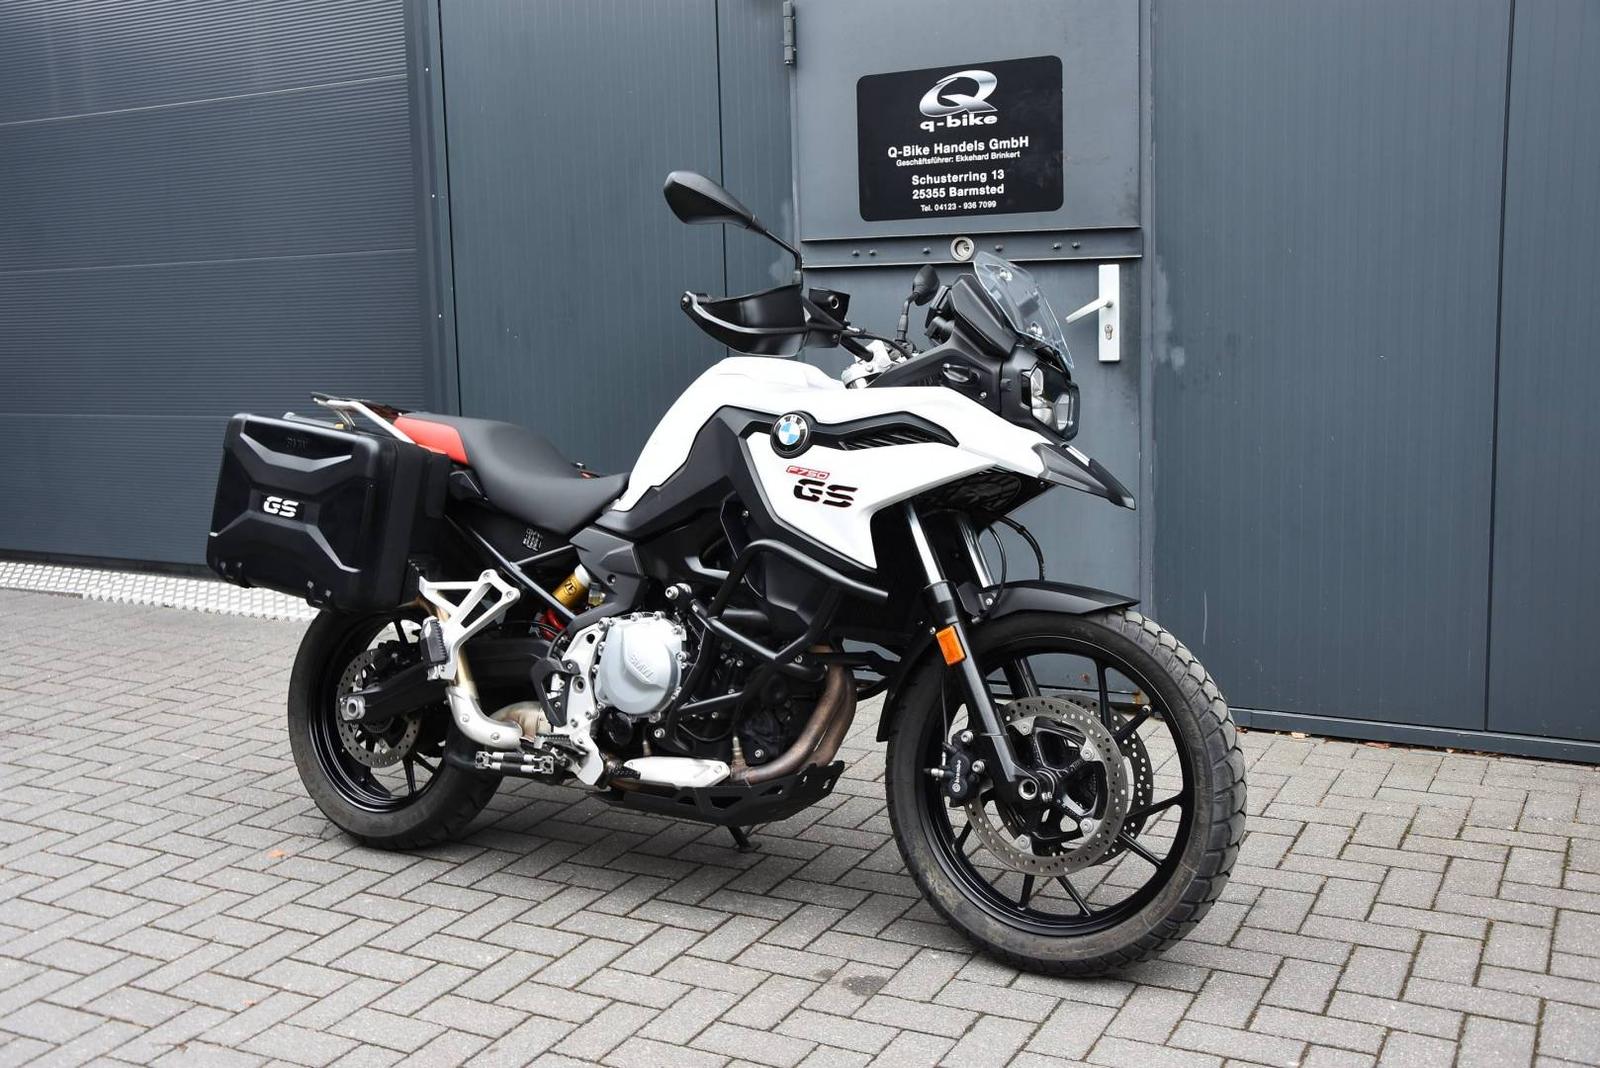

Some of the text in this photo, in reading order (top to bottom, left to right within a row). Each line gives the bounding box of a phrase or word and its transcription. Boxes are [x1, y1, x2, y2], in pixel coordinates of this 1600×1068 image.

[920, 114, 997, 132] q-bike
[888, 136, 1029, 158] Q-Bike Handels GmbH
[896, 150, 1020, 167] Geschäftsführer: Ekkehard Brinkert
[912, 169, 1004, 185] Schusterring 13
[912, 184, 1004, 199] 25355 Barmsted
[921, 204, 933, 212] Tel.
[935, 203, 956, 211] 04123
[979, 201, 996, 209] 7099
[793, 478, 858, 508] GS
[263, 496, 299, 517] GS
